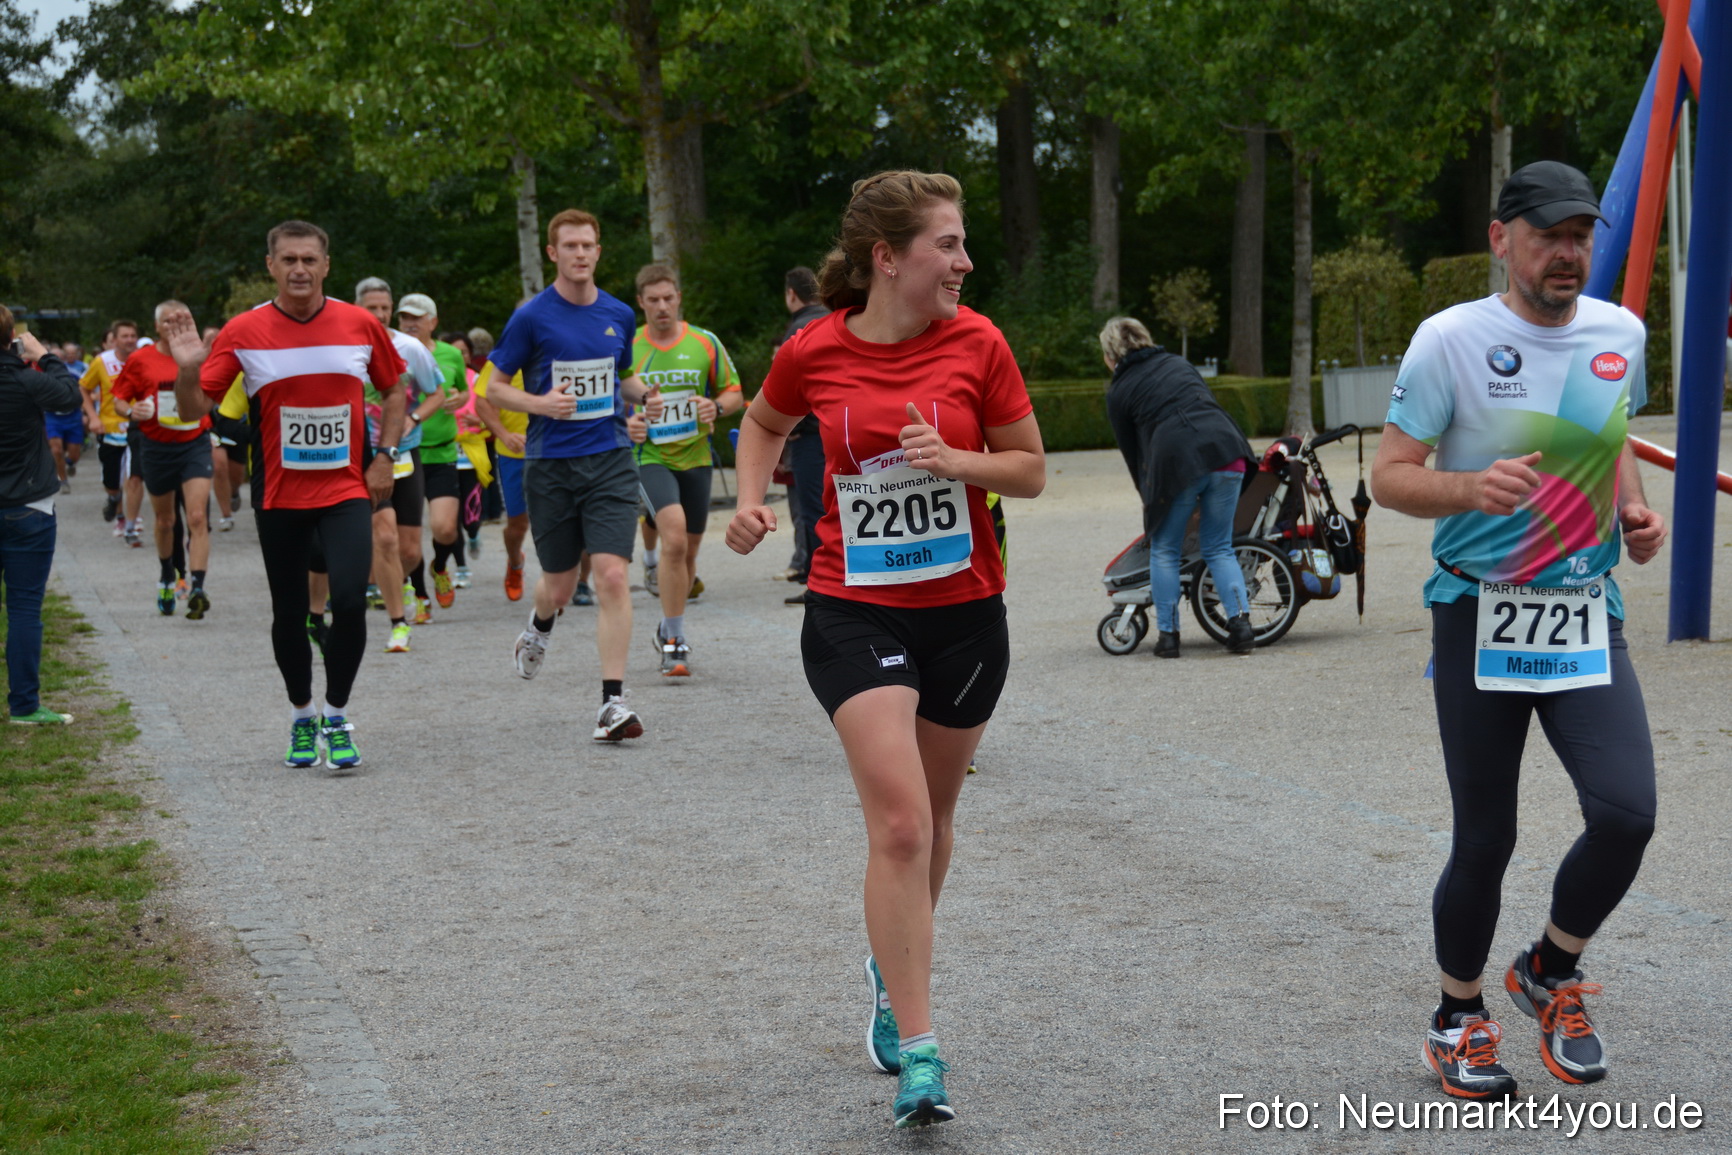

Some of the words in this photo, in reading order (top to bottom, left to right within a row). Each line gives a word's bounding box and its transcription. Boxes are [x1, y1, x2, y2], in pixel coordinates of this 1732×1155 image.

[1595, 360, 1625, 373] Hervis
[561, 373, 607, 397] 2511
[1488, 382, 1527, 391] PARTL
[283, 412, 306, 420] PARTL
[308, 412, 340, 420] Neumarkt
[651, 402, 692, 424] 714
[289, 421, 345, 446] 2095
[299, 450, 337, 461] Michael
[881, 454, 908, 469] DEH
[838, 482, 877, 494] PARTL
[880, 474, 940, 493] Neumarkt
[852, 488, 957, 538] 2205
[884, 546, 933, 568] Sarah
[1483, 583, 1527, 595] PARTL
[1530, 587, 1585, 597] Neumarkt
[1492, 601, 1589, 645] 2721
[1506, 656, 1578, 675] Matthias
